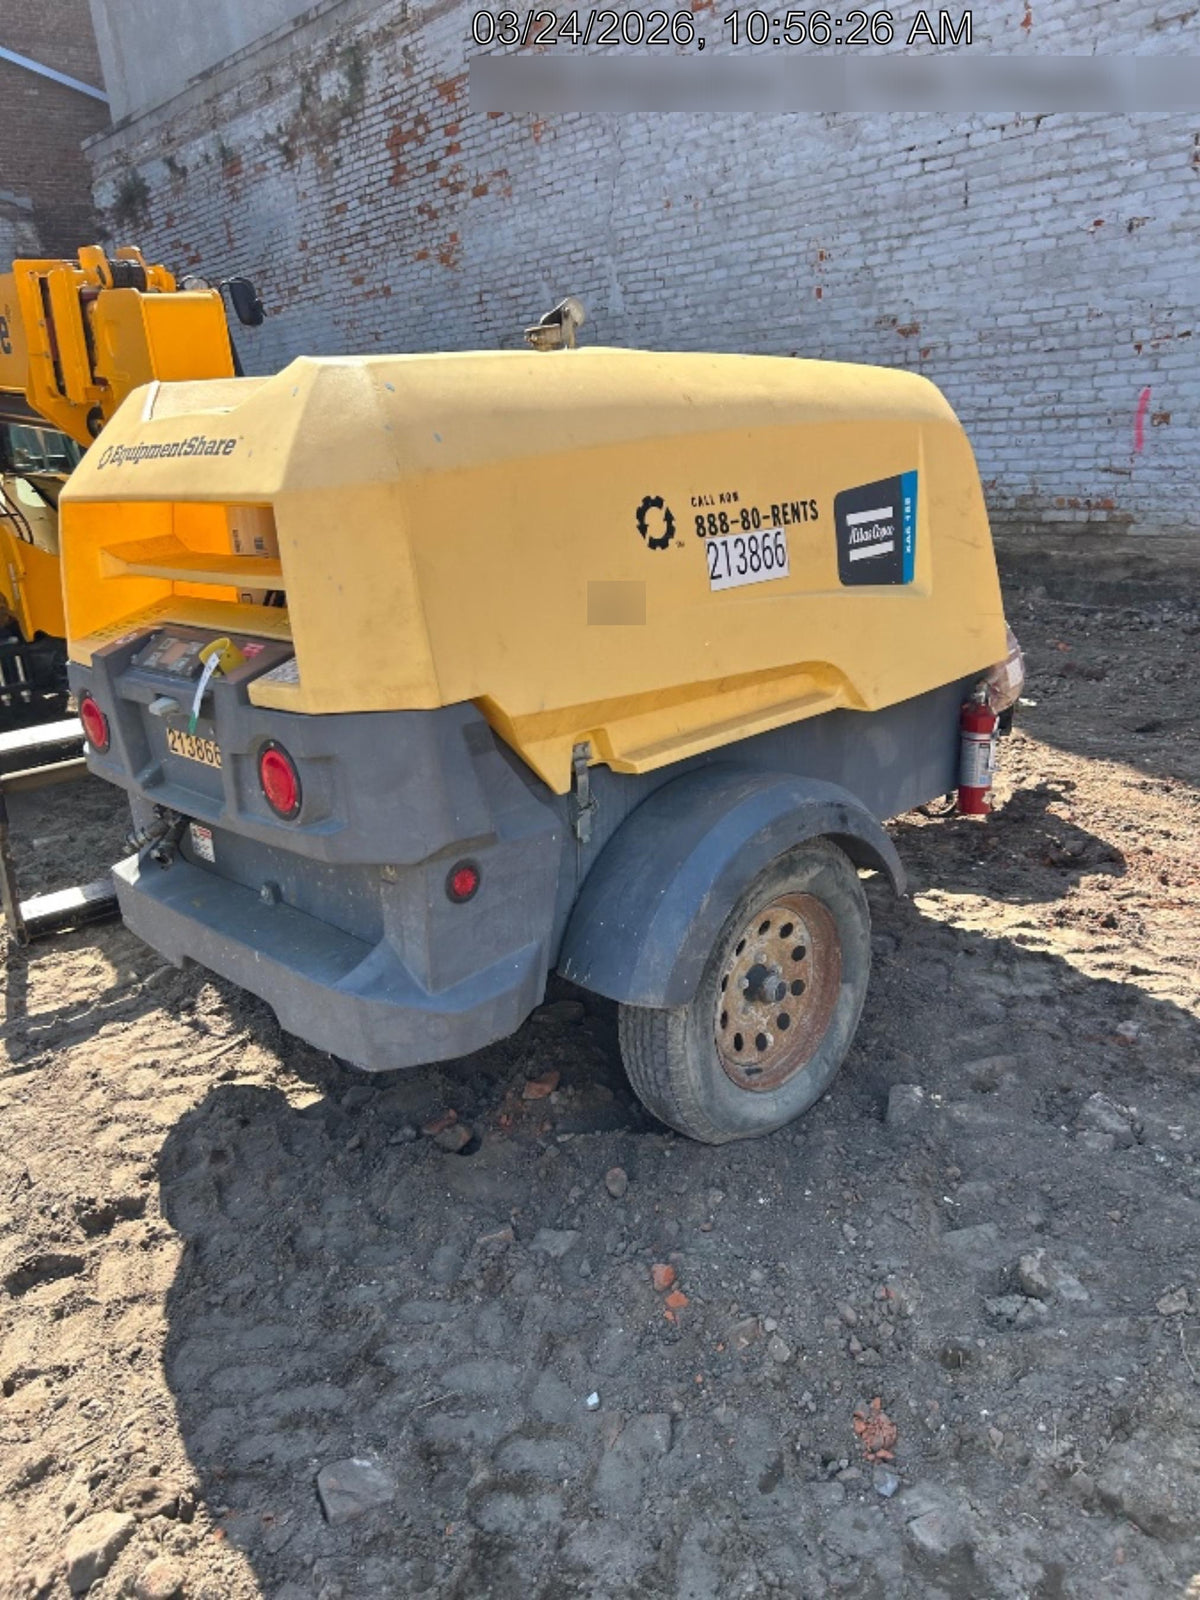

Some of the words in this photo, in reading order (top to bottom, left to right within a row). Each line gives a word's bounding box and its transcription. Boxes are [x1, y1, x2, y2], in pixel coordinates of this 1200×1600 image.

[110, 435, 237, 466] EquipmentShare
[690, 495, 716, 507] CALL
[694, 499, 819, 537] 888-80-RENTS
[848, 526, 872, 545] Atlas
[707, 531, 786, 580] 213866
